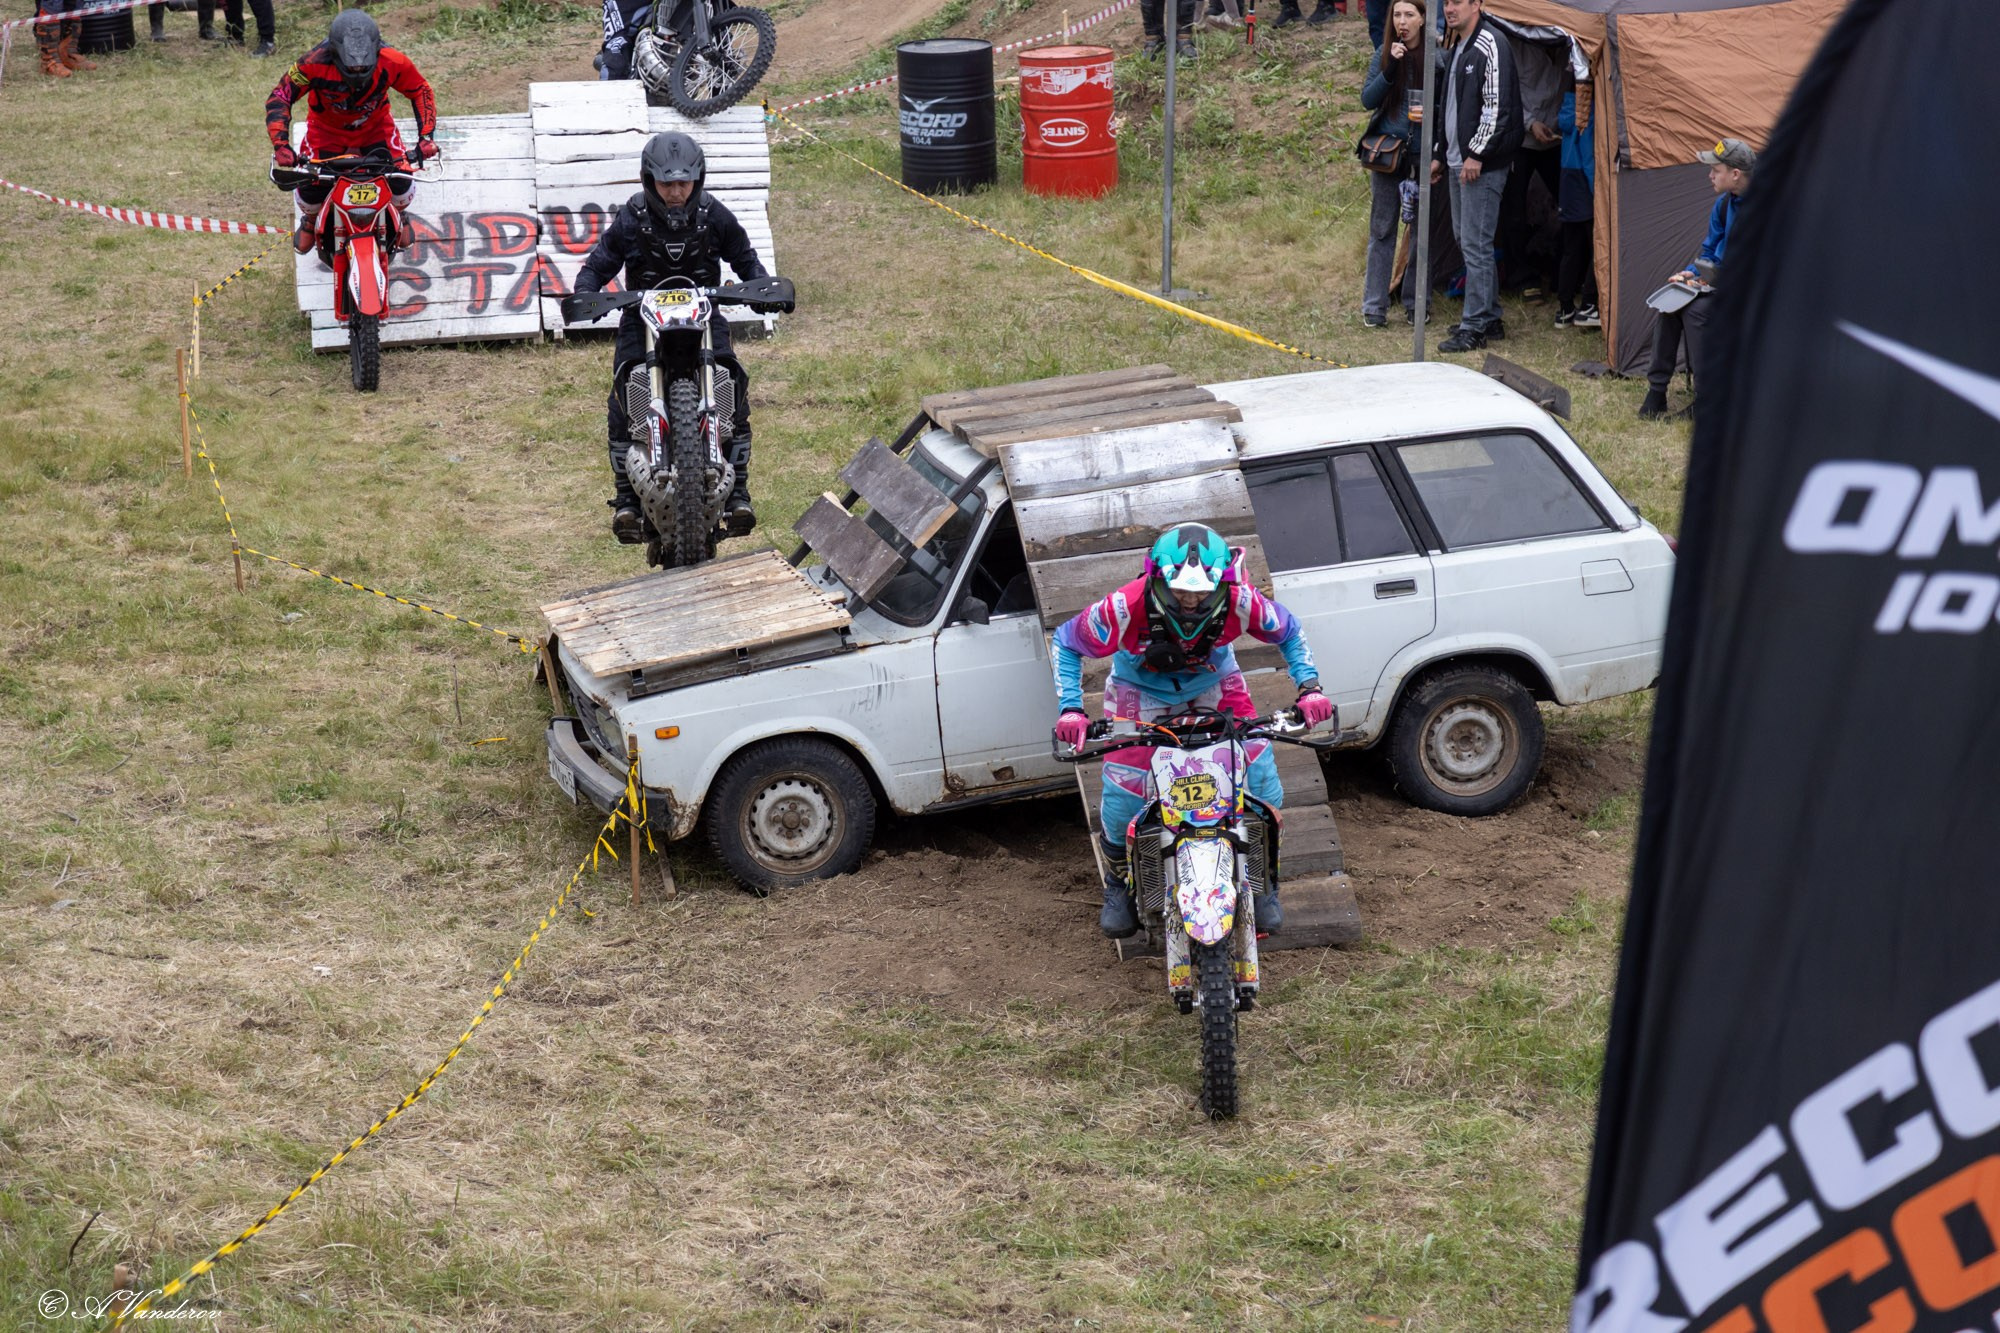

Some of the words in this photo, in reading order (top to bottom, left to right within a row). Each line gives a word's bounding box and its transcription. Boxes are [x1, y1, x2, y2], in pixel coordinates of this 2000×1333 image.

[899, 109, 967, 128] ECORD
[920, 128, 956, 137] RADIO
[1041, 126, 1085, 136] SINTEC
[357, 191, 369, 200] 17
[402, 203, 628, 267] NDU
[661, 295, 686, 303] 710
[652, 415, 662, 461] RIEJU
[709, 416, 719, 463] RIEJU
[1873, 571, 2000, 635] 10
[1183, 786, 1204, 802] 12
[1695, 1154, 2000, 1333] CO
